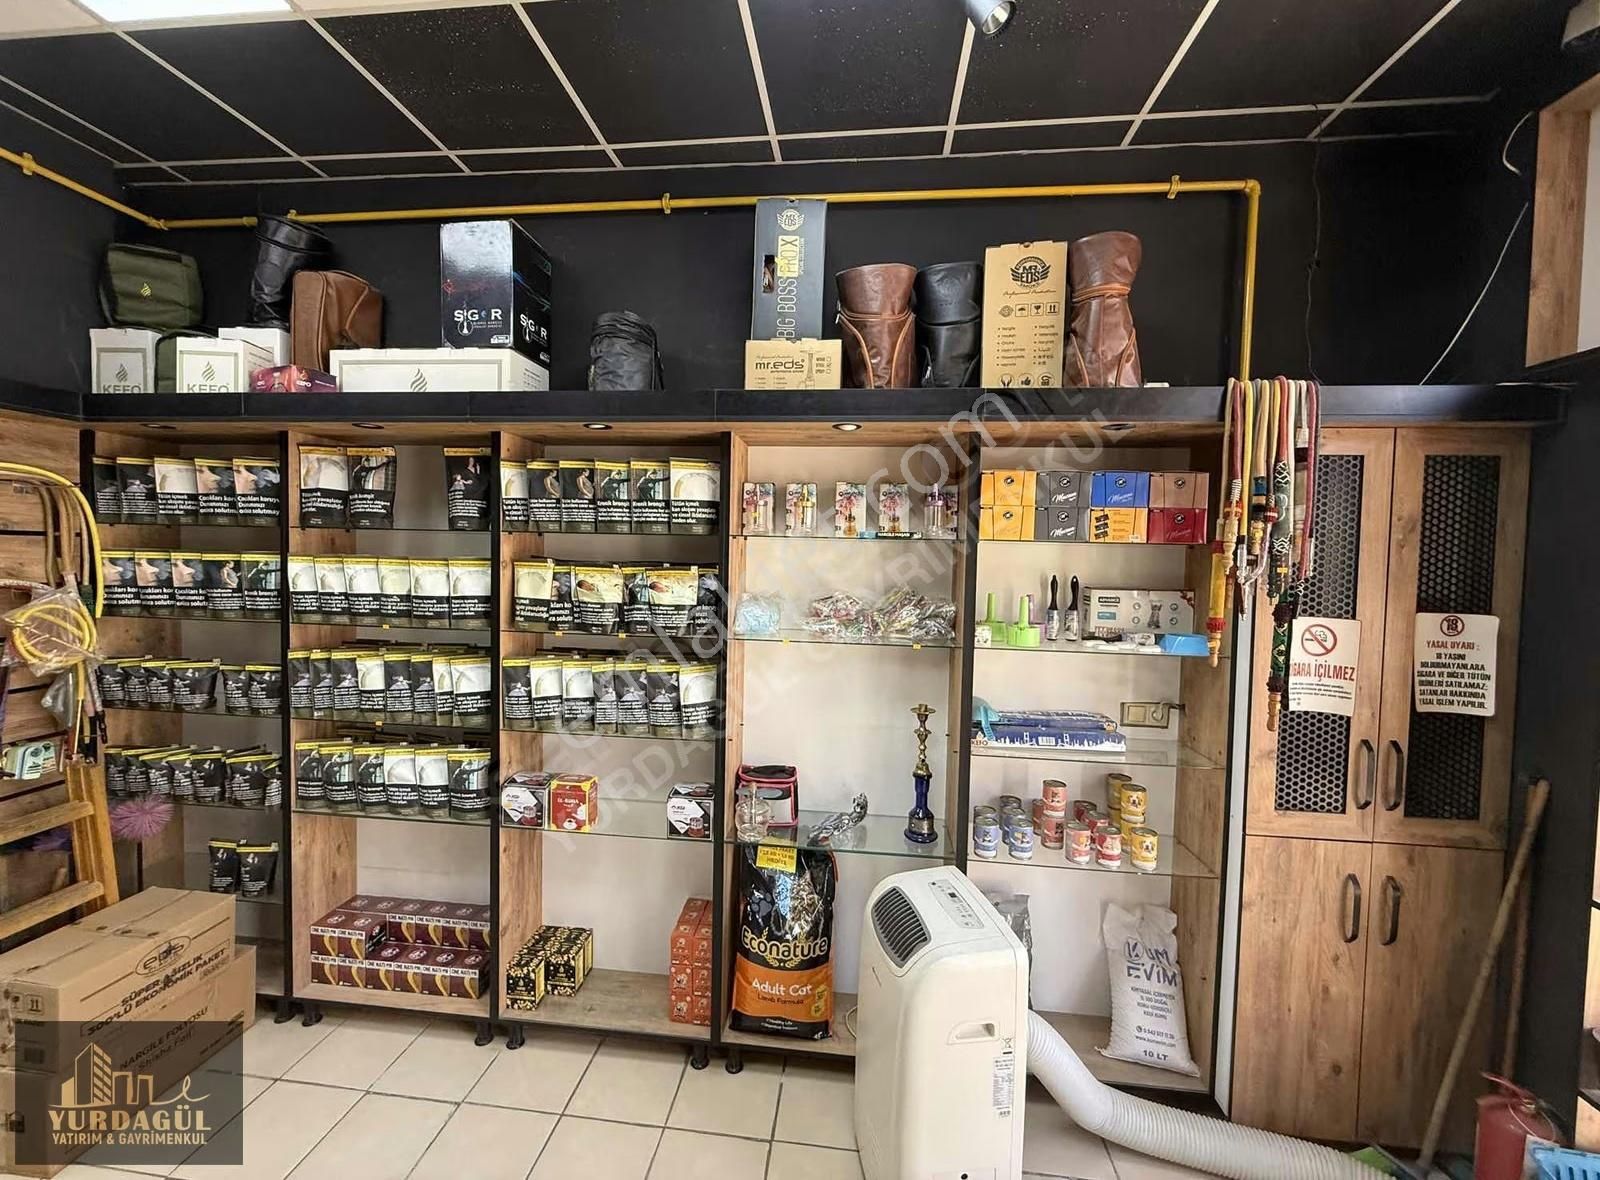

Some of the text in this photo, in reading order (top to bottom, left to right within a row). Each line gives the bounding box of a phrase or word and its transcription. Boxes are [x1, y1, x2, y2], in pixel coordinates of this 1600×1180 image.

[777, 278, 798, 313] BOSS
[777, 318, 796, 337] BIG
[755, 360, 804, 370] mr.eds
[1427, 640, 1448, 648] YASAL
[1450, 642, 1474, 650] UYARI
[1314, 659, 1355, 682] İÇİLMEZ
[742, 925, 828, 960] Econature
[195, 948, 226, 971] PAKET
[752, 978, 812, 996] Adult Cat
[1157, 1052, 1169, 1061] LT
